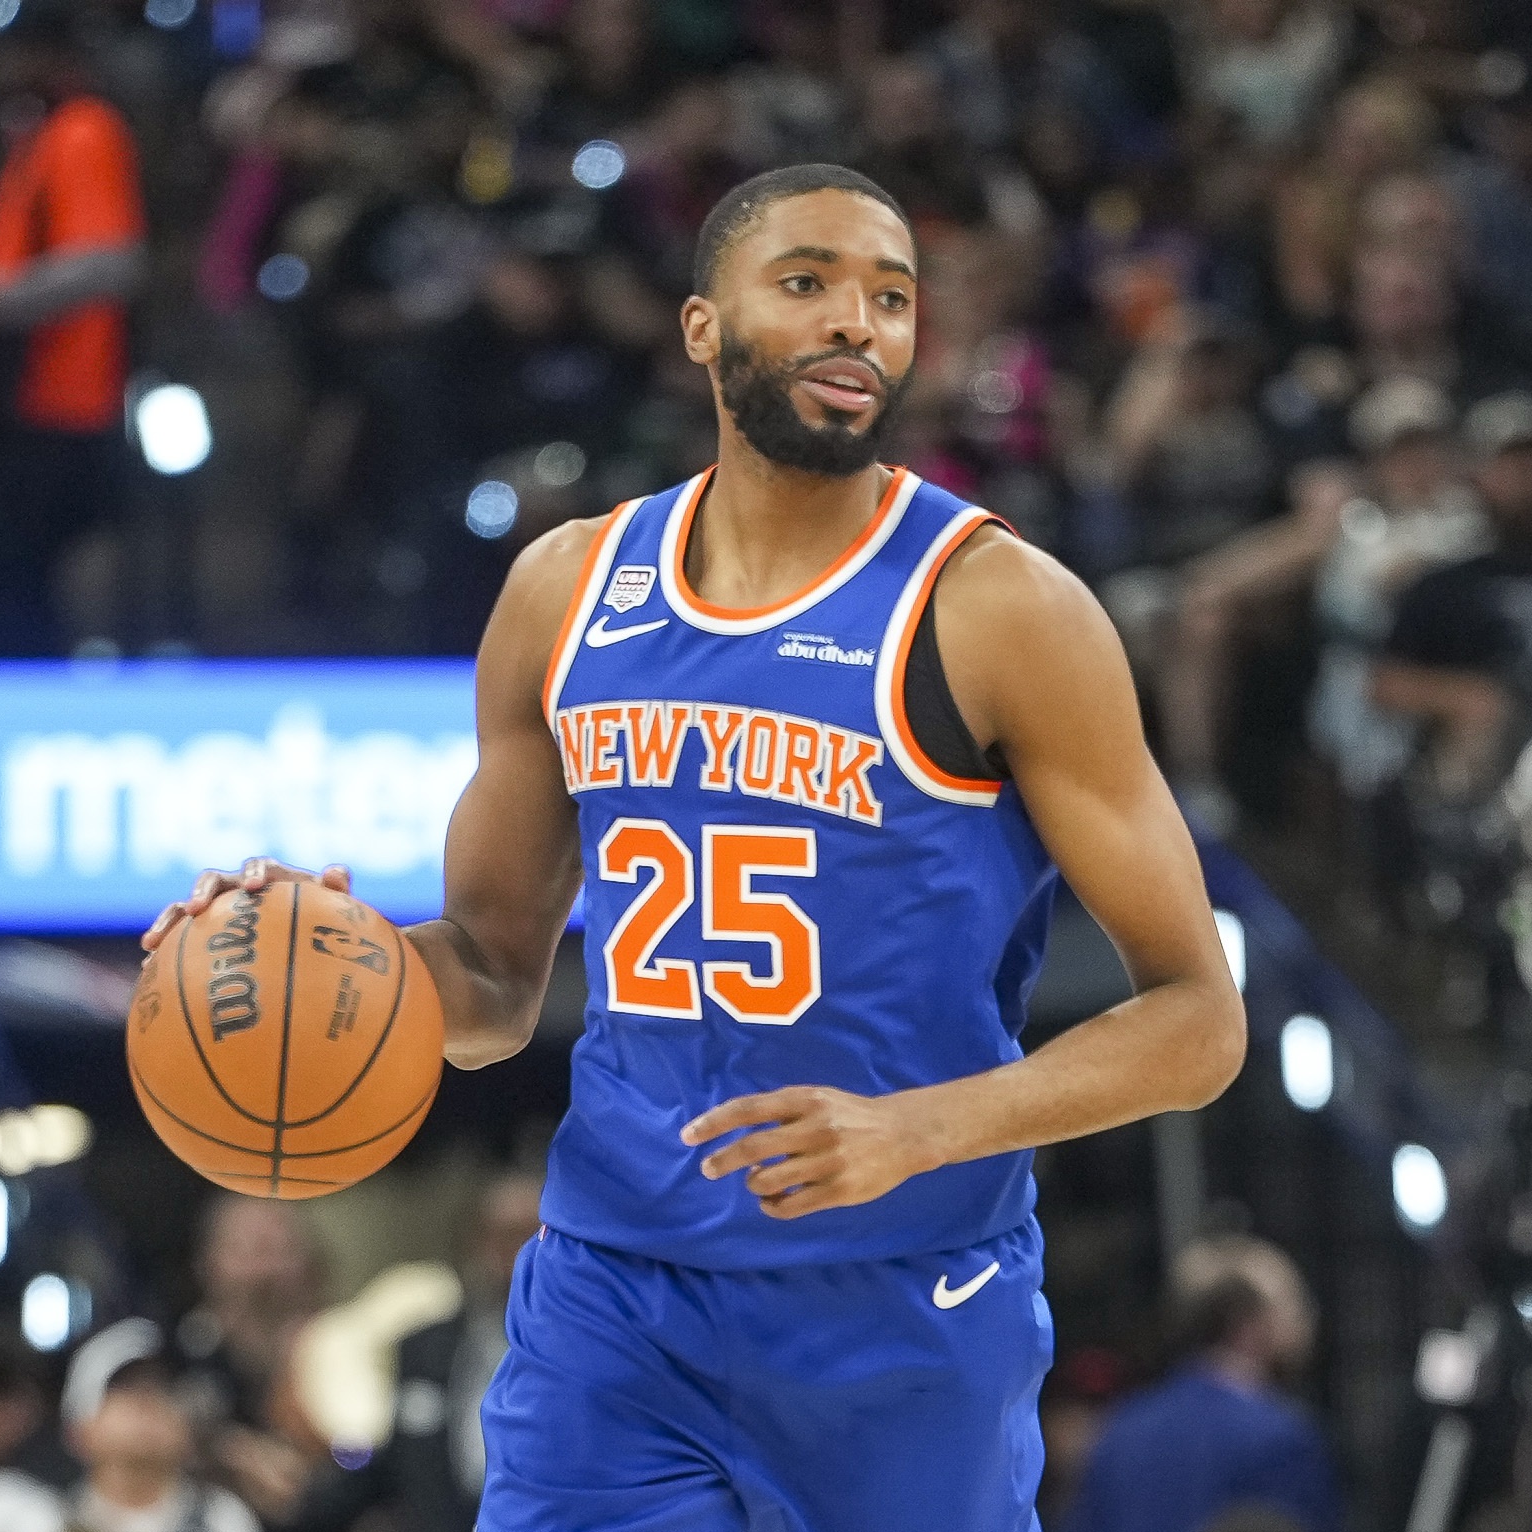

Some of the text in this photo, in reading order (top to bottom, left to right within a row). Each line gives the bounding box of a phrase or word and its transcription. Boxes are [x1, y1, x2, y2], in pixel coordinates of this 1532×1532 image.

[777, 641, 877, 667] abu dhabi
[556, 700, 884, 828] NEW YORK
[204, 883, 271, 1044] Wilso
[598, 816, 822, 1026] 25
